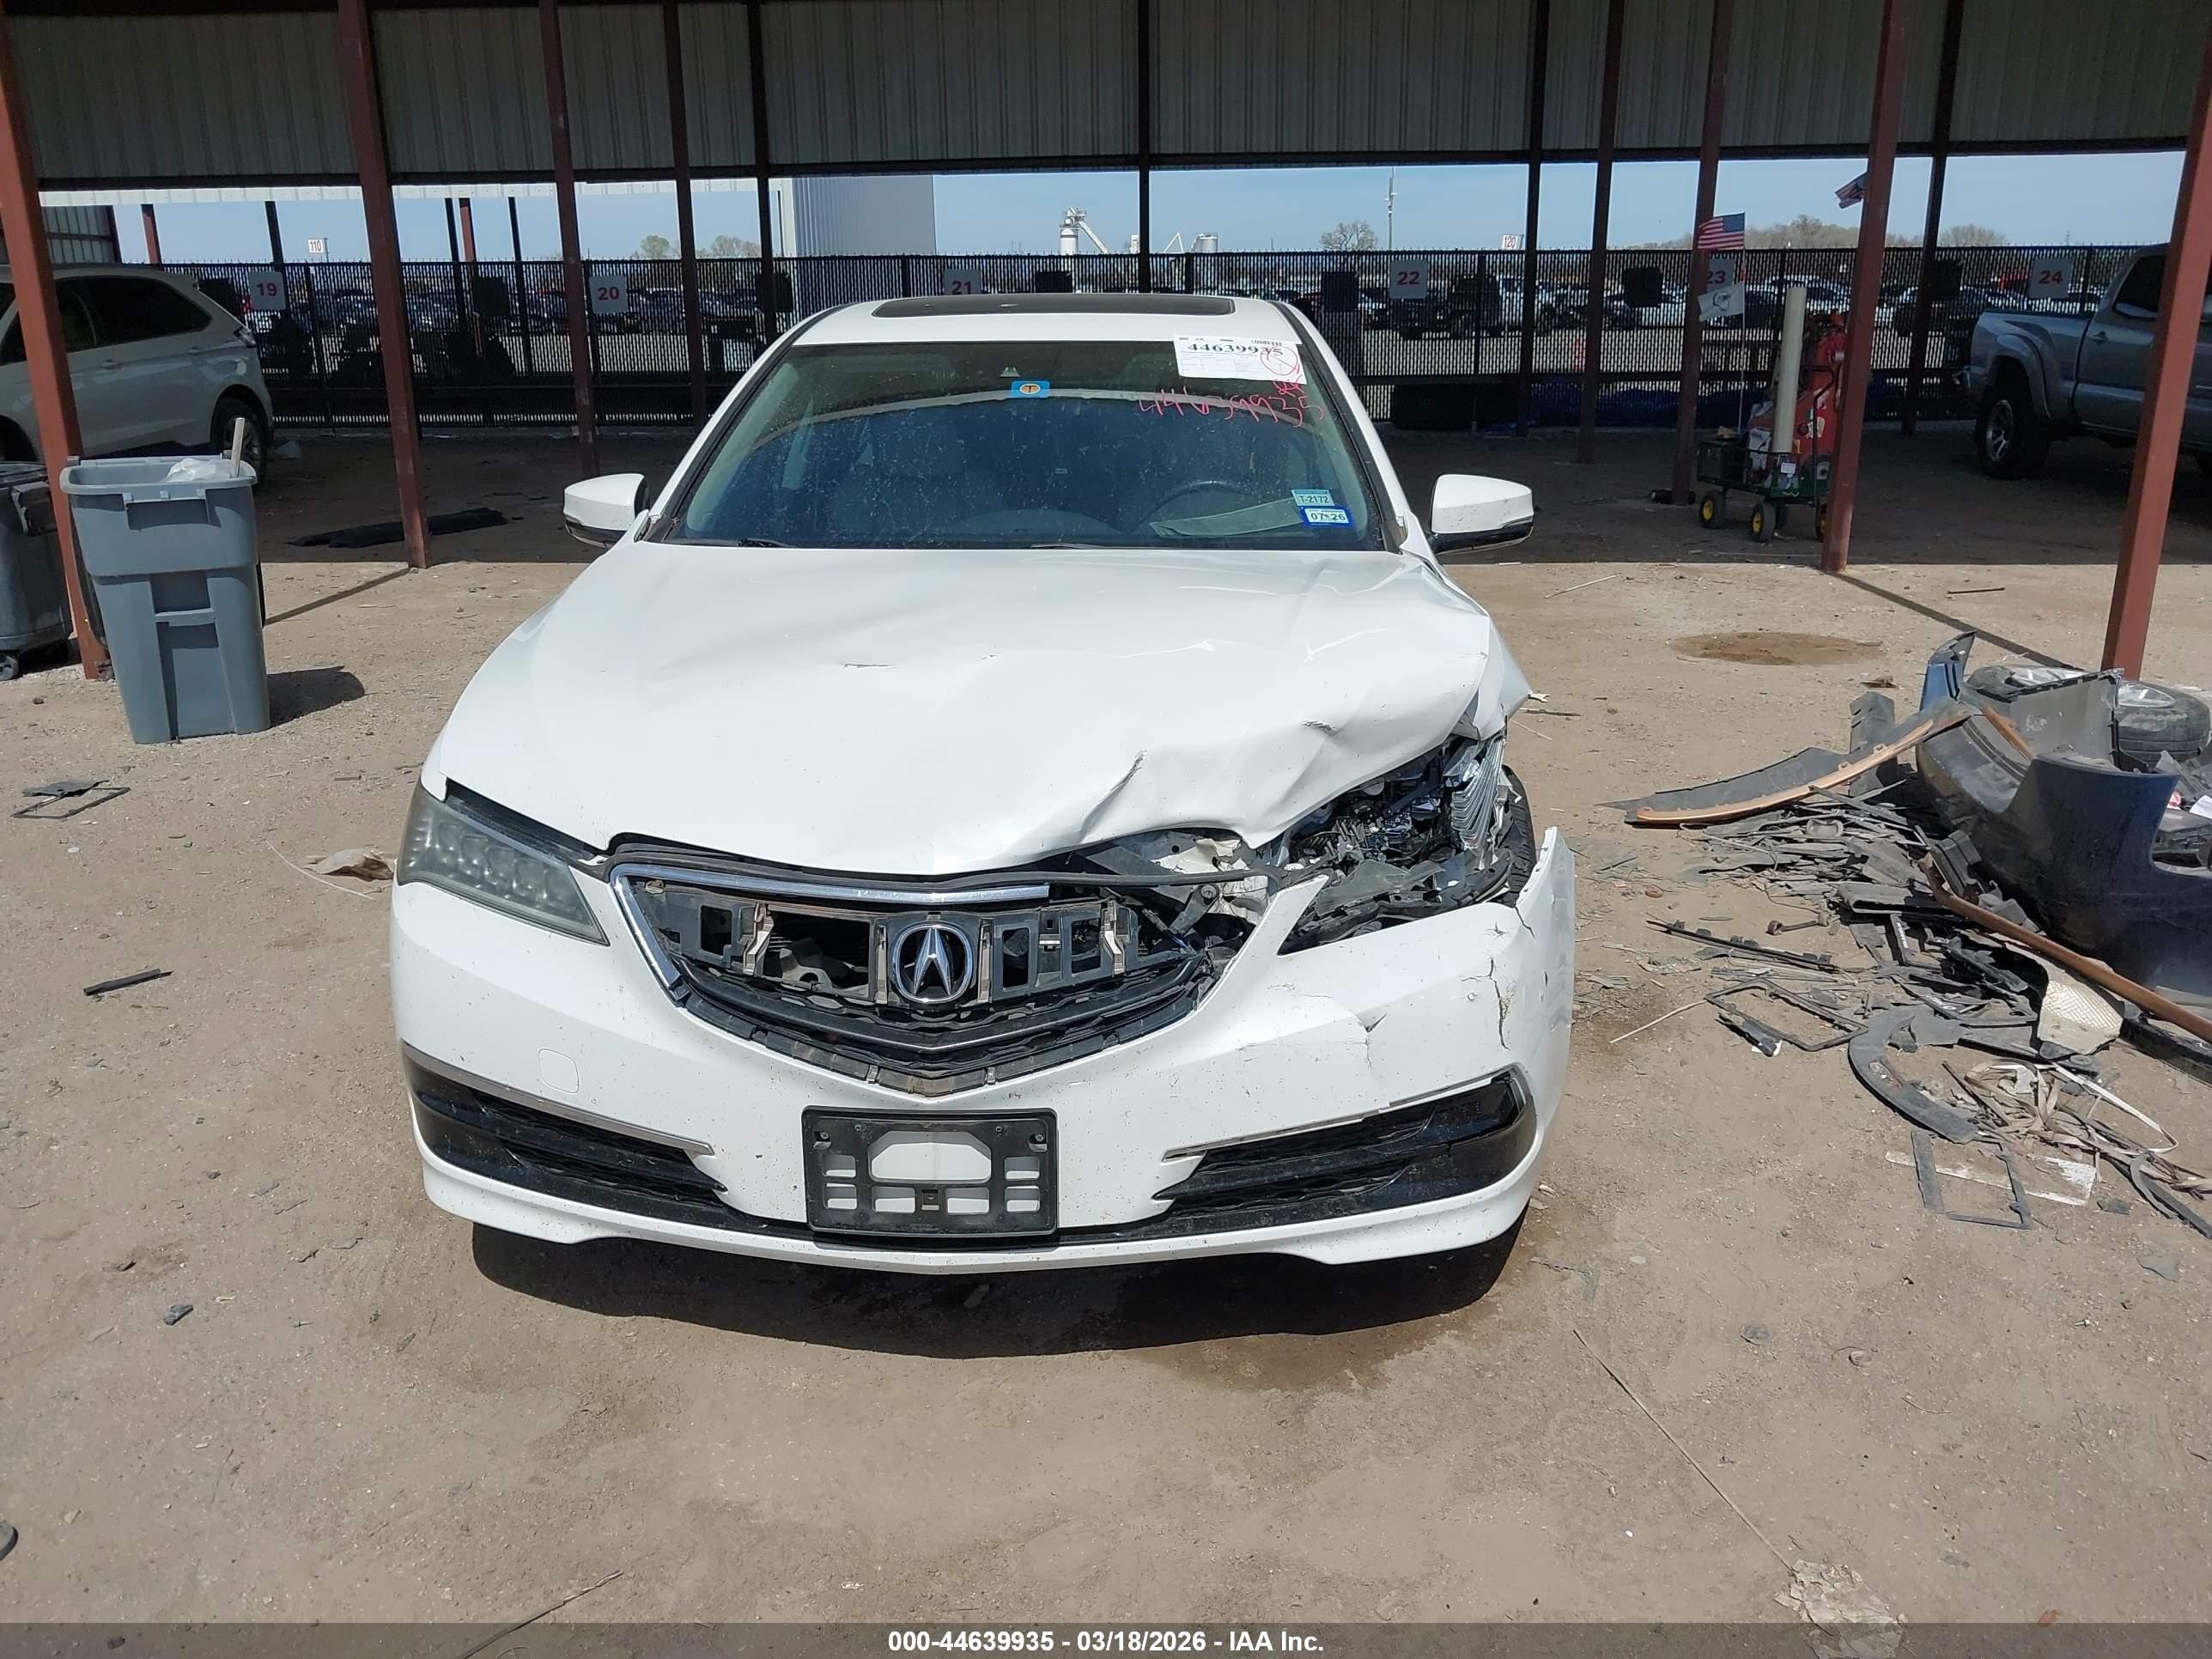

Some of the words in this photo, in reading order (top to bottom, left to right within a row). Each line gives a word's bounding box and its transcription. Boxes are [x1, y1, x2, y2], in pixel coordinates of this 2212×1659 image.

[310, 240, 322, 252] 110
[1504, 235, 1516, 248] 120
[1397, 270, 1420, 285] 22
[2039, 270, 2063, 283] 24
[256, 283, 277, 296] 19
[598, 286, 620, 301] 20
[951, 280, 972, 295] 21
[1188, 343, 1284, 356] 44639935
